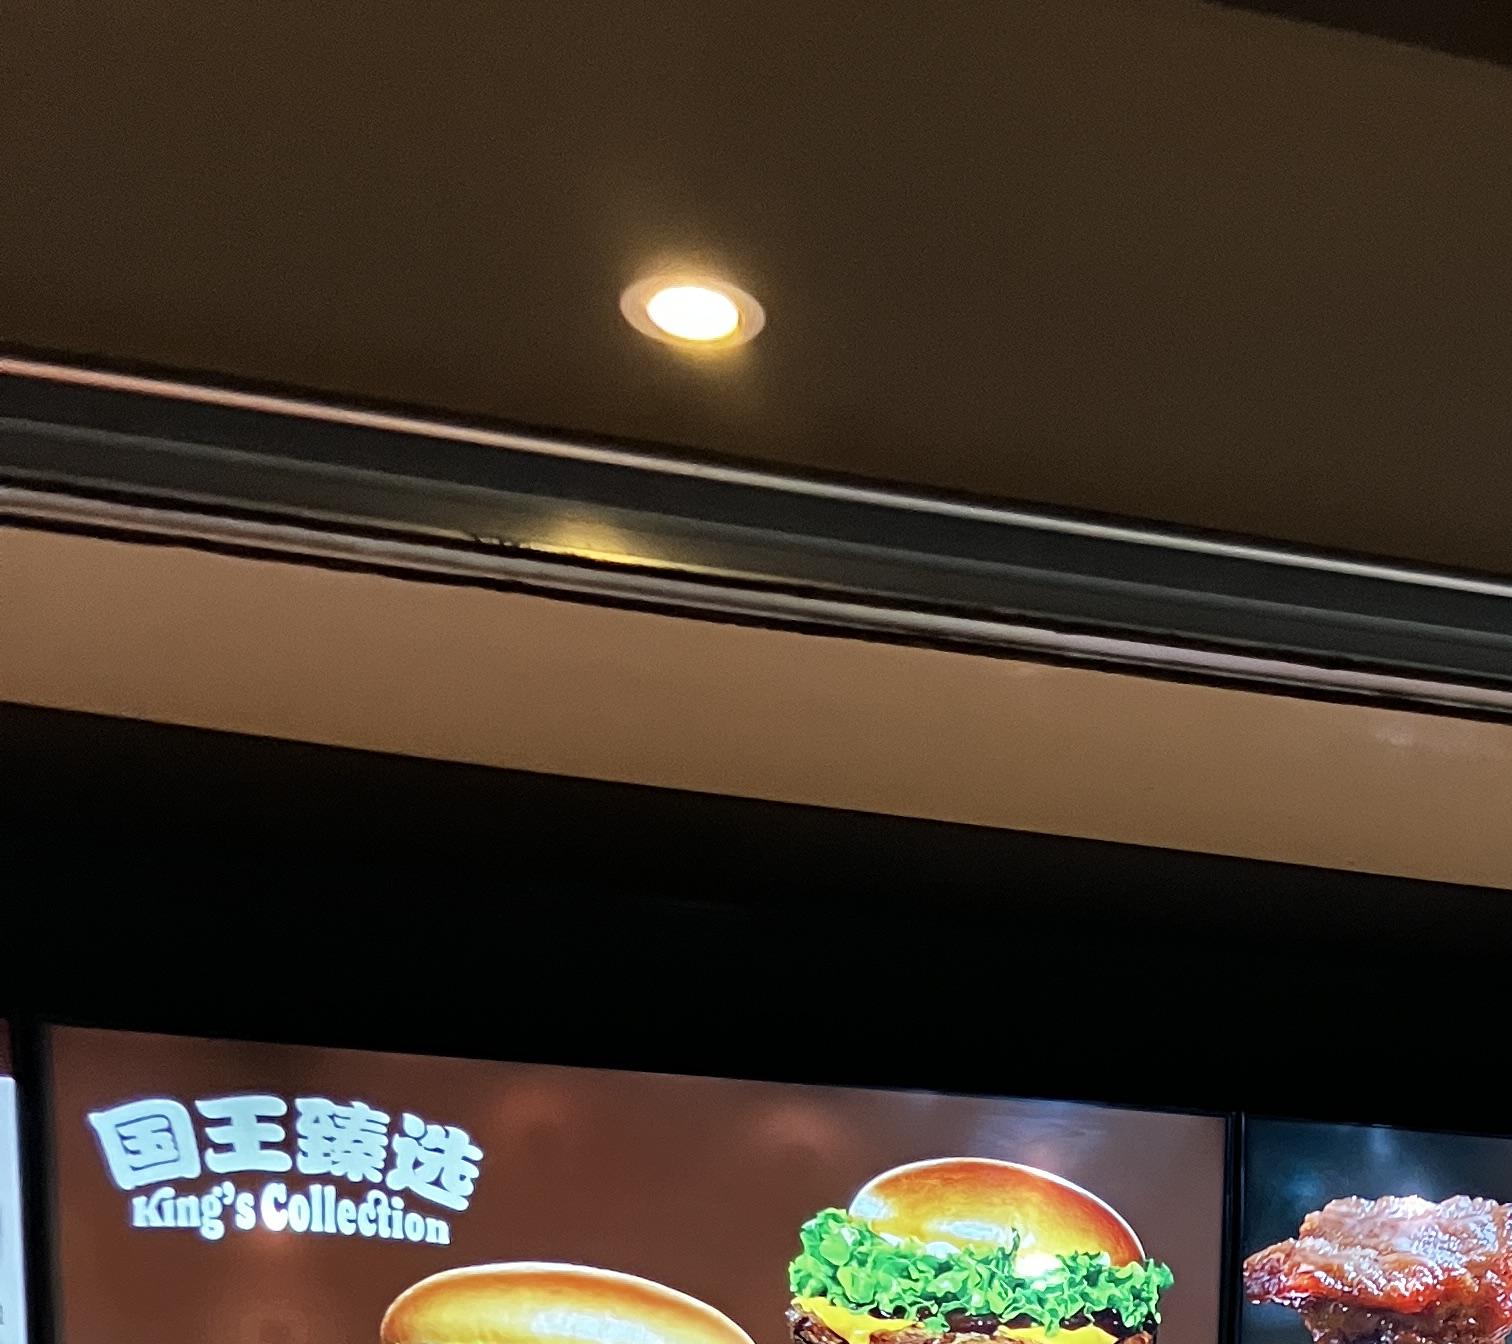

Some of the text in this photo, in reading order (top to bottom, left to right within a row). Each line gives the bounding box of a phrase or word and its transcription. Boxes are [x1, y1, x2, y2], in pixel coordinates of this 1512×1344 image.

[89, 1095, 484, 1211] 国王臻选
[132, 1182, 450, 1245] King's Collection
